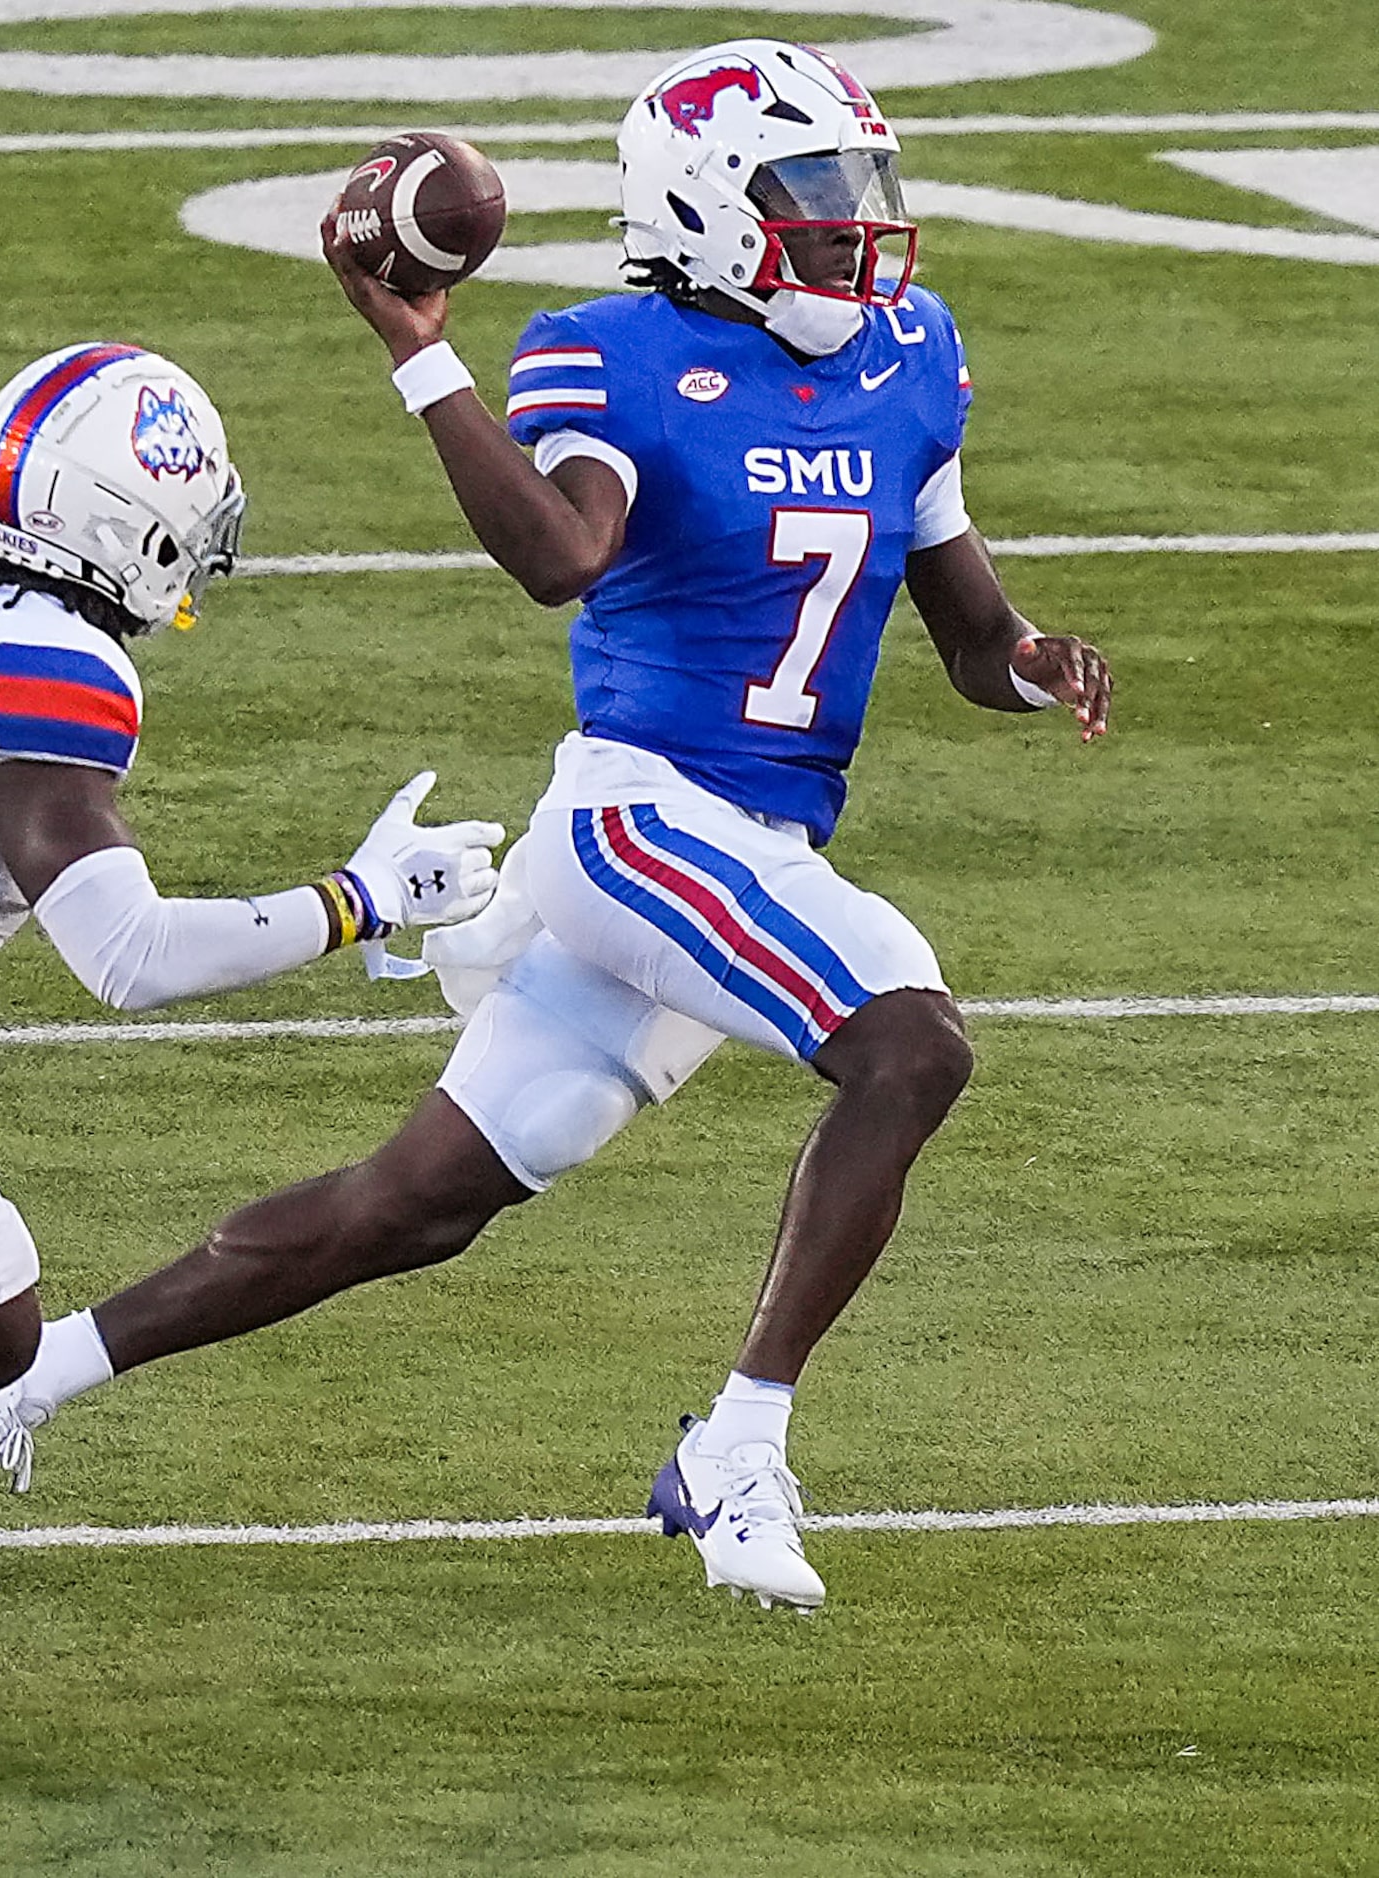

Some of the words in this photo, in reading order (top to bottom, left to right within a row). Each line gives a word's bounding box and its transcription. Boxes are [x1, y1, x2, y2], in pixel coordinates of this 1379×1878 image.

[883, 298, 926, 346] C
[685, 374, 720, 393] ACC
[744, 447, 873, 496] SMU
[743, 506, 874, 730] 7
